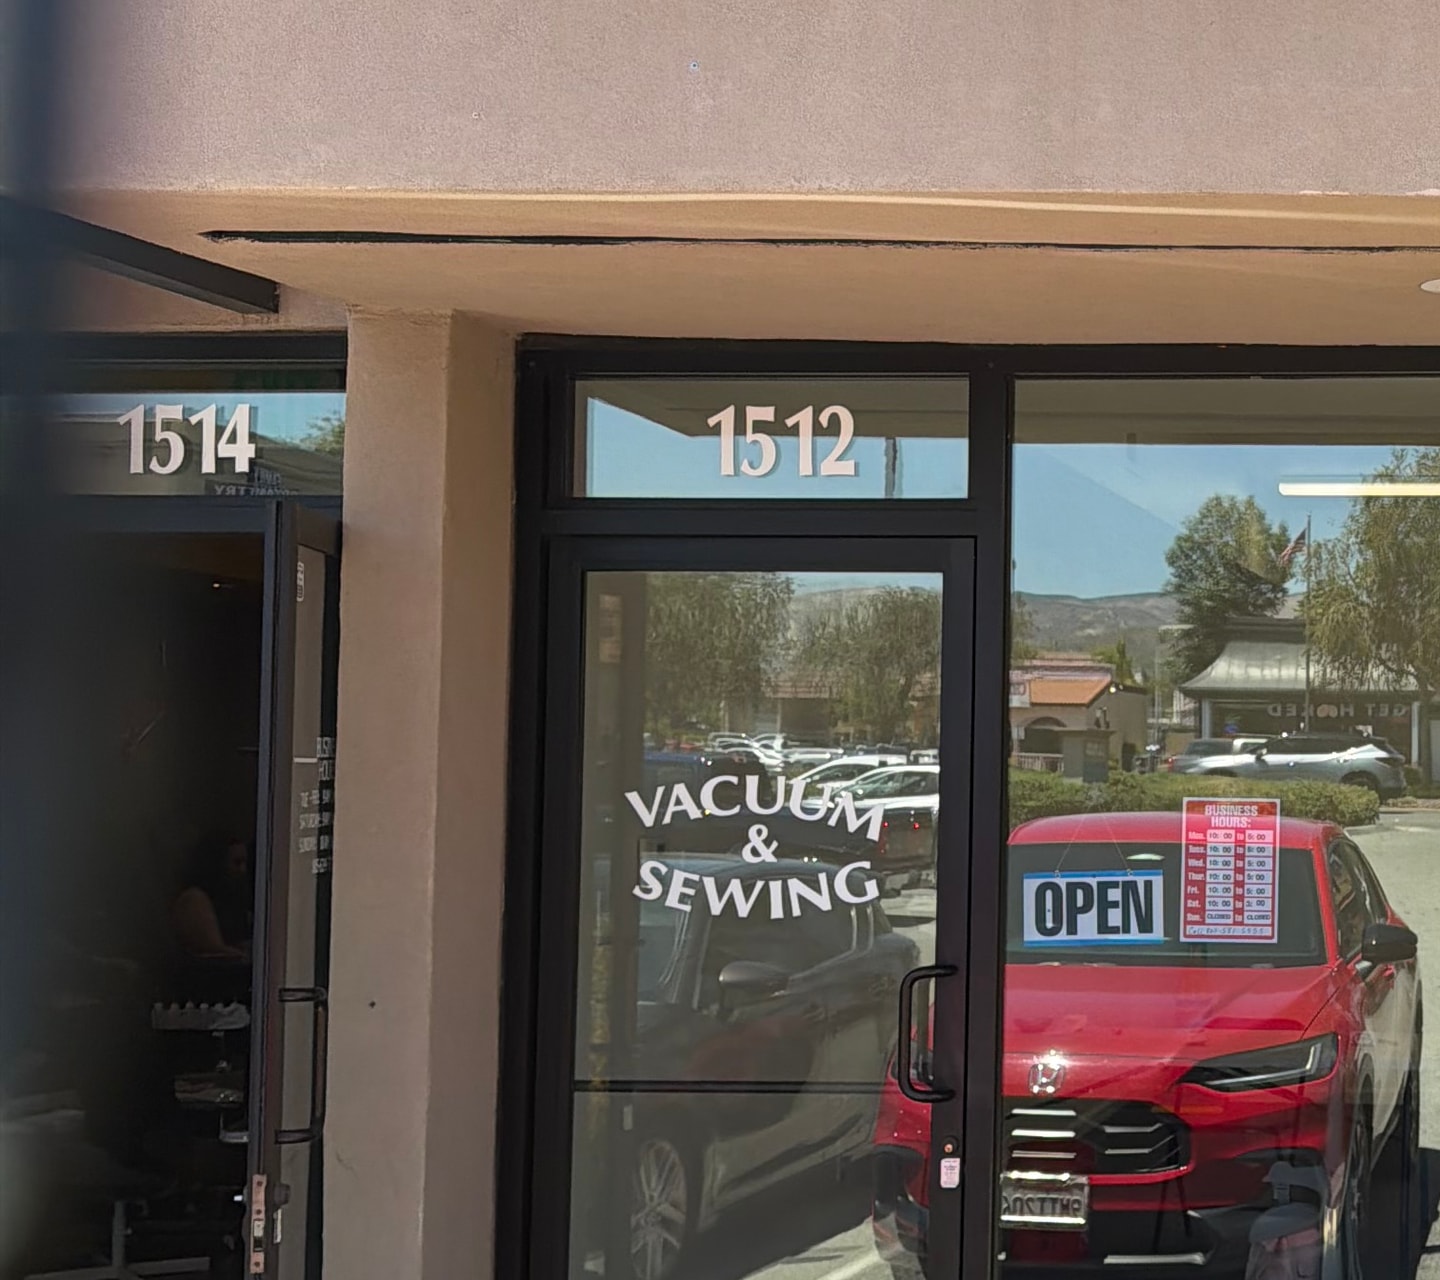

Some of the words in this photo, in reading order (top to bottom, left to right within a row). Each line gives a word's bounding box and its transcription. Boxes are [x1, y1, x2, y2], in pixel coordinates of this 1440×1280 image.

[116, 402, 256, 475] 1514
[706, 403, 856, 477] 1512
[624, 773, 886, 842] VACUUM
[1205, 804, 1258, 816] BUSINESS
[1211, 816, 1252, 828] HOURS:
[741, 824, 779, 864] &
[631, 860, 881, 920] SEWING
[1034, 879, 1154, 937] OPEN
